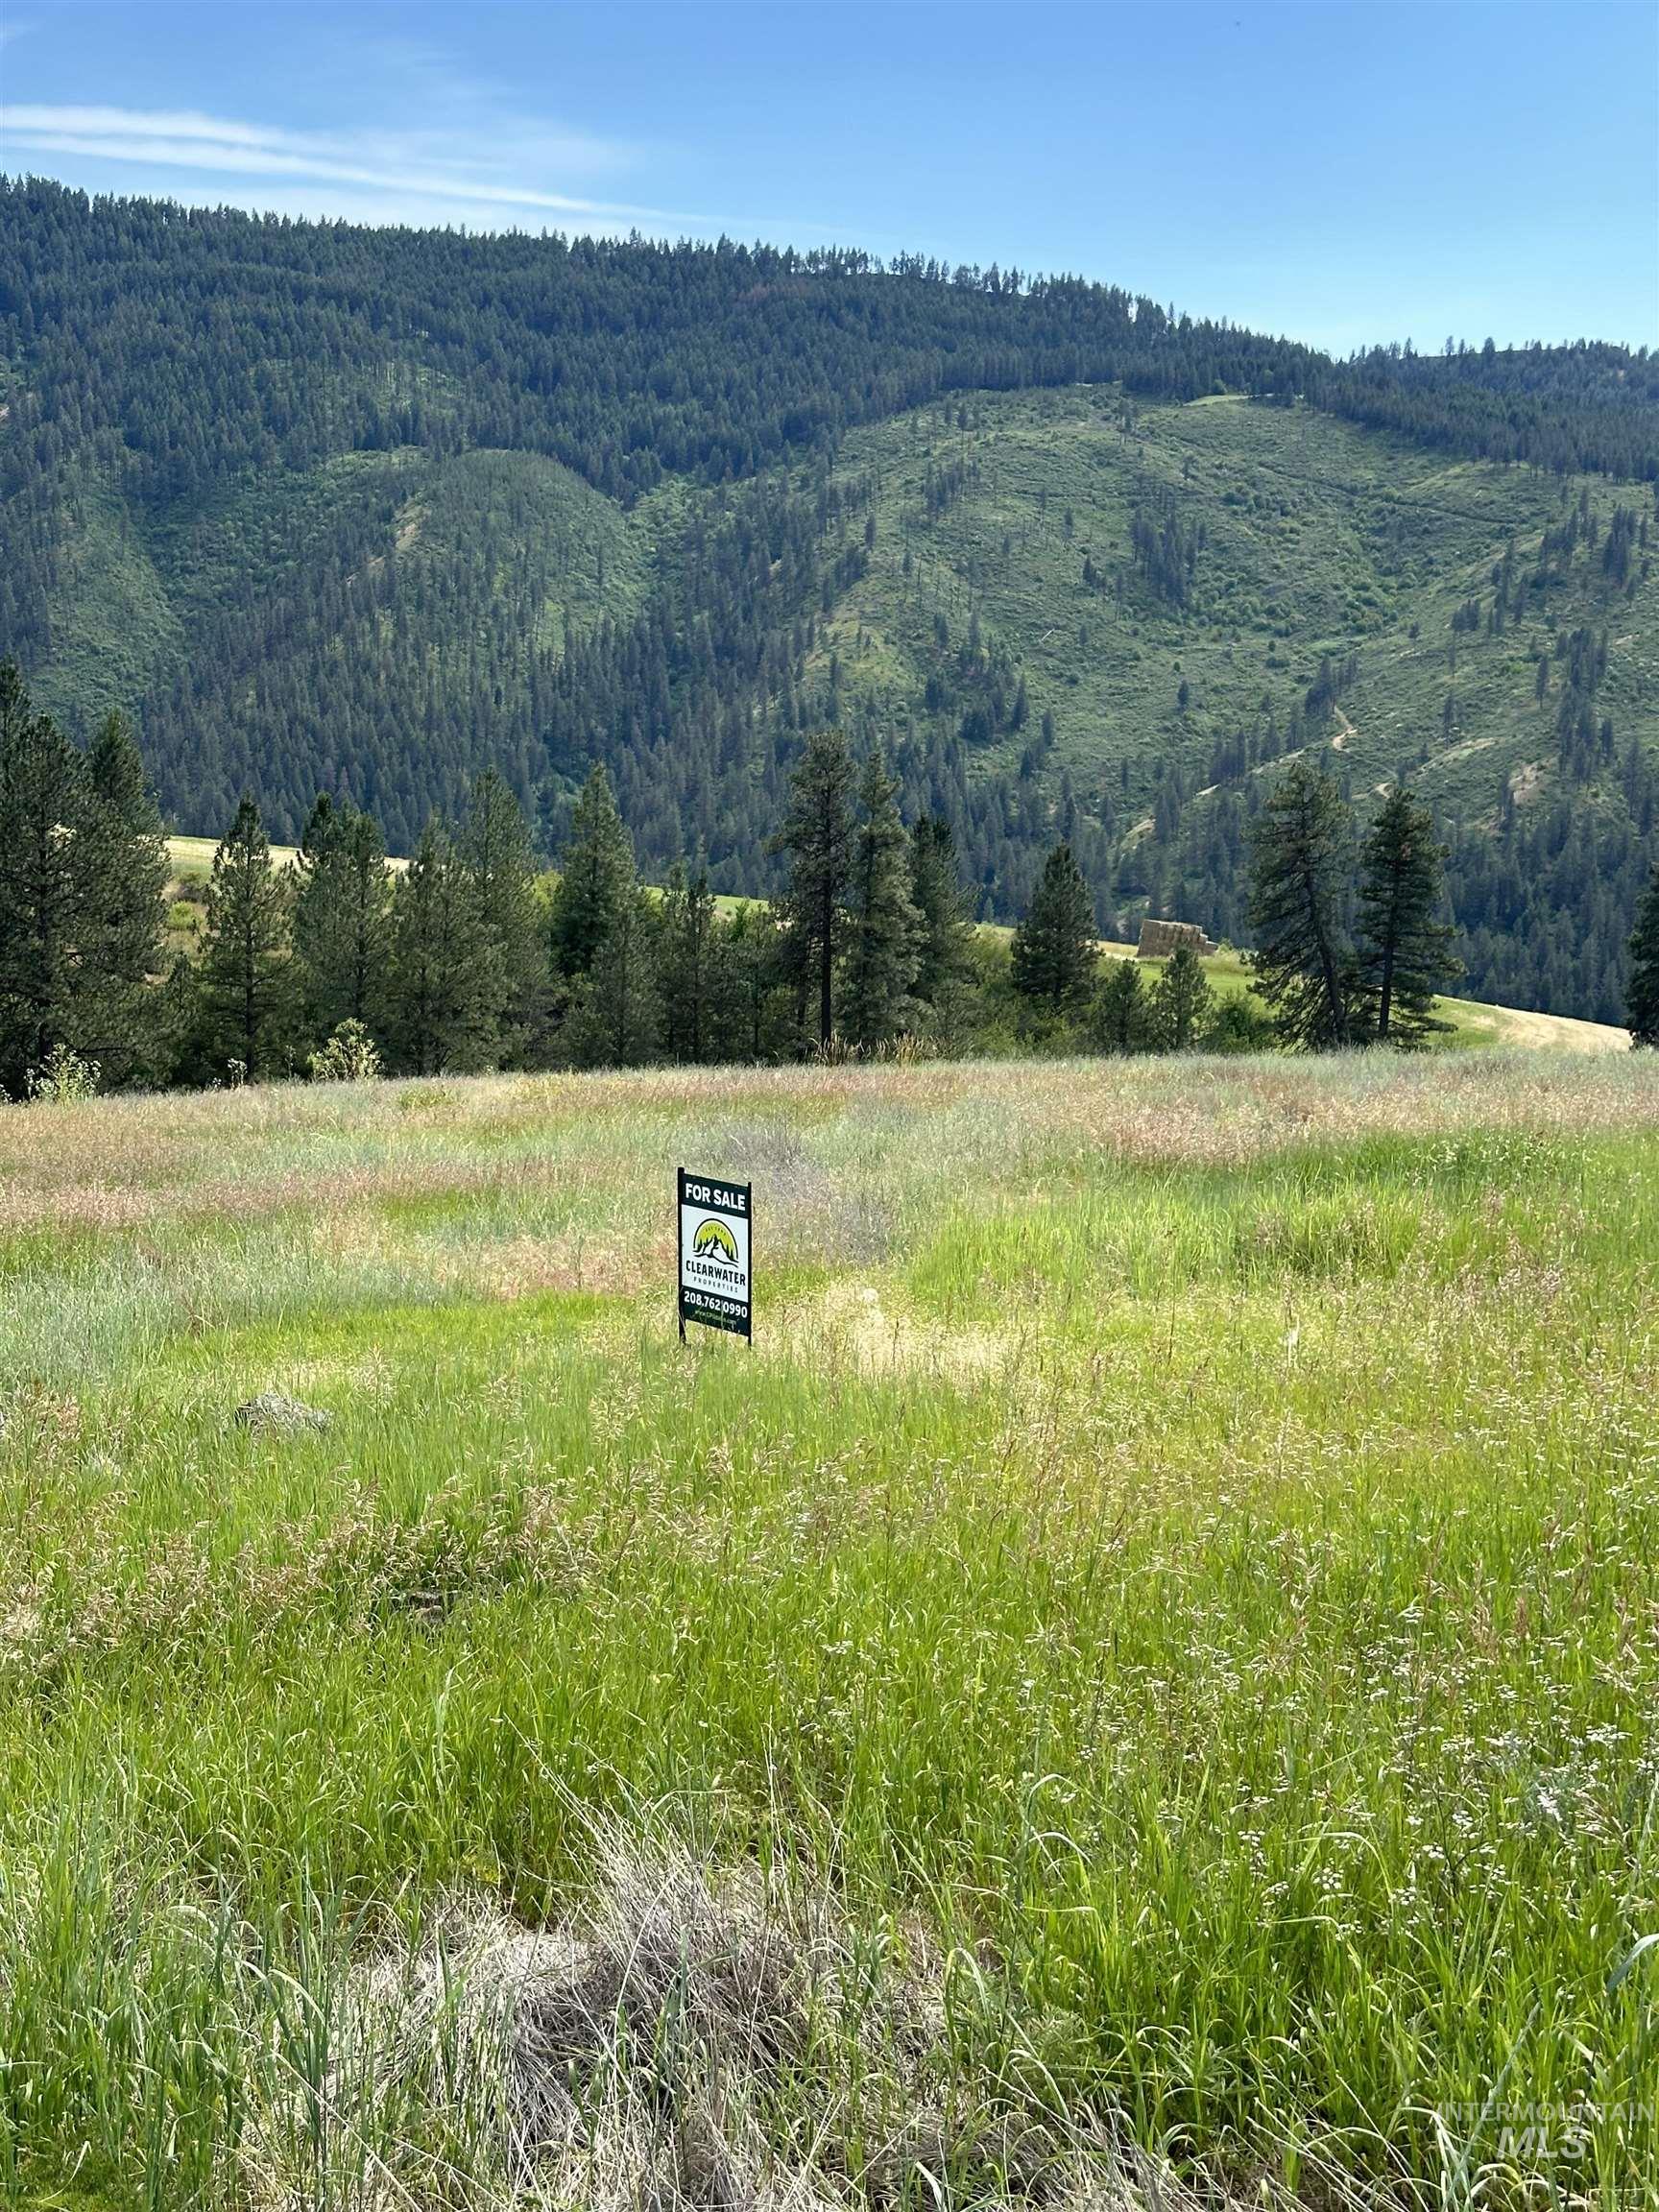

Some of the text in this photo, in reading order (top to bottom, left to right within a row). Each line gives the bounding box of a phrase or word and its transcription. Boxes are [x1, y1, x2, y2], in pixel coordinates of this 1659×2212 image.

[685, 1183, 746, 1211] FOR SALE
[685, 1260, 746, 1286] CLEARWATER
[693, 1276, 738, 1293] PROPERTIES
[684, 1290, 748, 1318] 208.7620990
